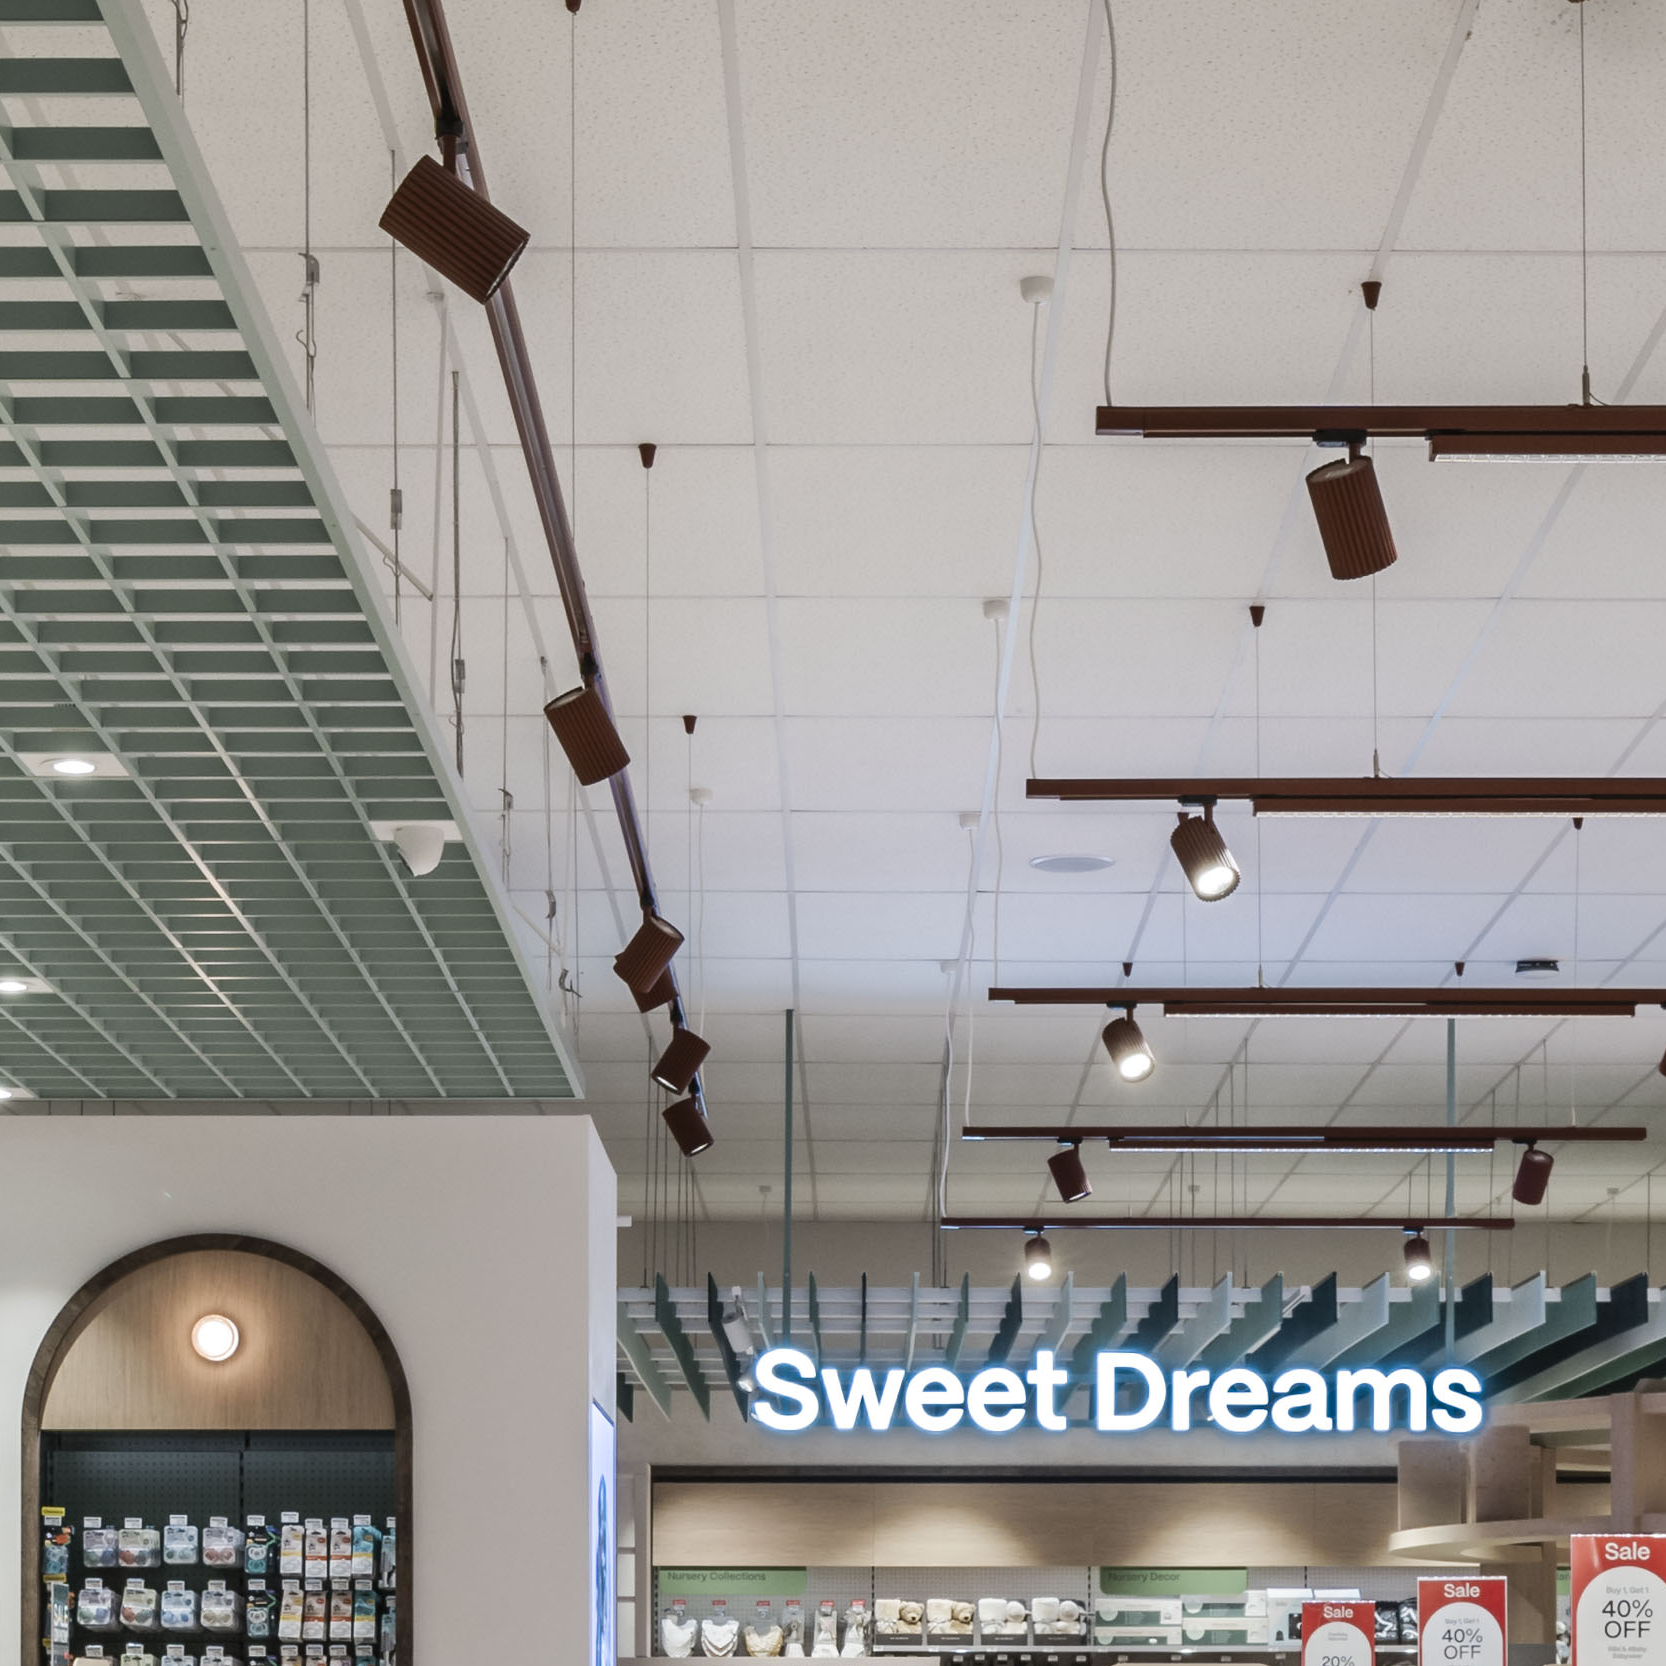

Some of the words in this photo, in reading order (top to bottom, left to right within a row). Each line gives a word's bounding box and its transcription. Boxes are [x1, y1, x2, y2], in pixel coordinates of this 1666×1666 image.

[753, 1348, 1067, 1432] Sweet
[1097, 1350, 1483, 1433] Dreams
[1605, 1542, 1651, 1561] Sale
[668, 1572, 707, 1582] Nursery
[710, 1572, 766, 1581] Collections
[1109, 1573, 1148, 1583] Nursery
[1150, 1573, 1180, 1581] Decor
[1444, 1583, 1480, 1598] Sale
[1323, 1606, 1354, 1619] Sale
[1602, 1600, 1653, 1618] 40%
[1442, 1628, 1483, 1643] 40%
[1605, 1620, 1651, 1638] OFF
[1444, 1645, 1481, 1660] OFF
